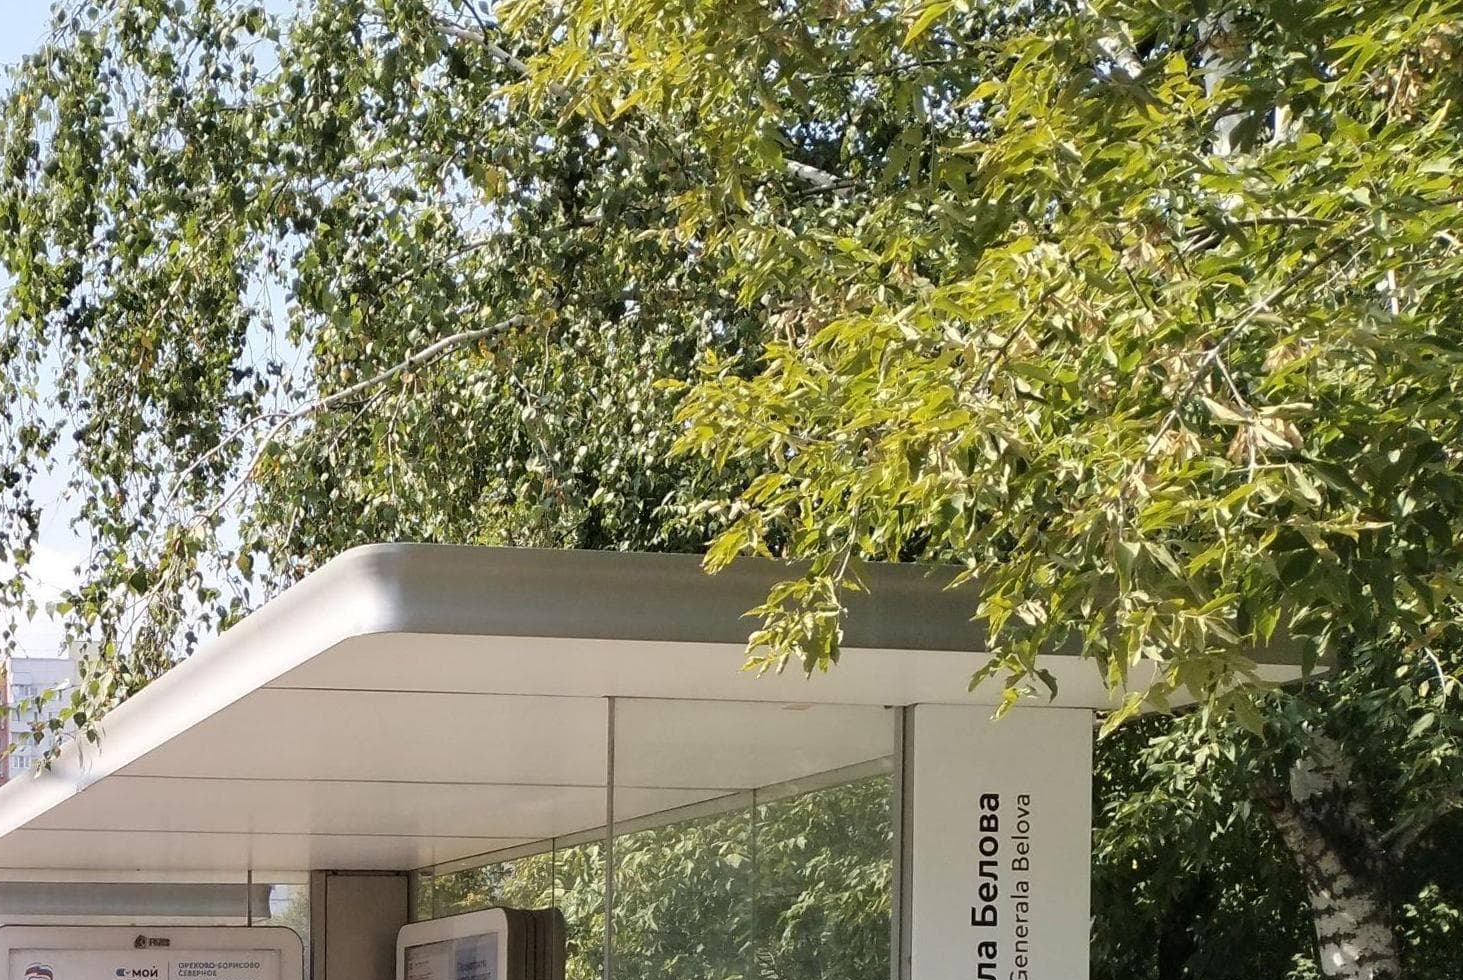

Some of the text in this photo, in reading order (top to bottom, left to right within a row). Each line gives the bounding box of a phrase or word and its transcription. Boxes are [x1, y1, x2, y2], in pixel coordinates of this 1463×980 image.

[971, 794, 999, 926] Белова
[1011, 795, 1030, 871] Belova
[132, 965, 158, 978] мой
